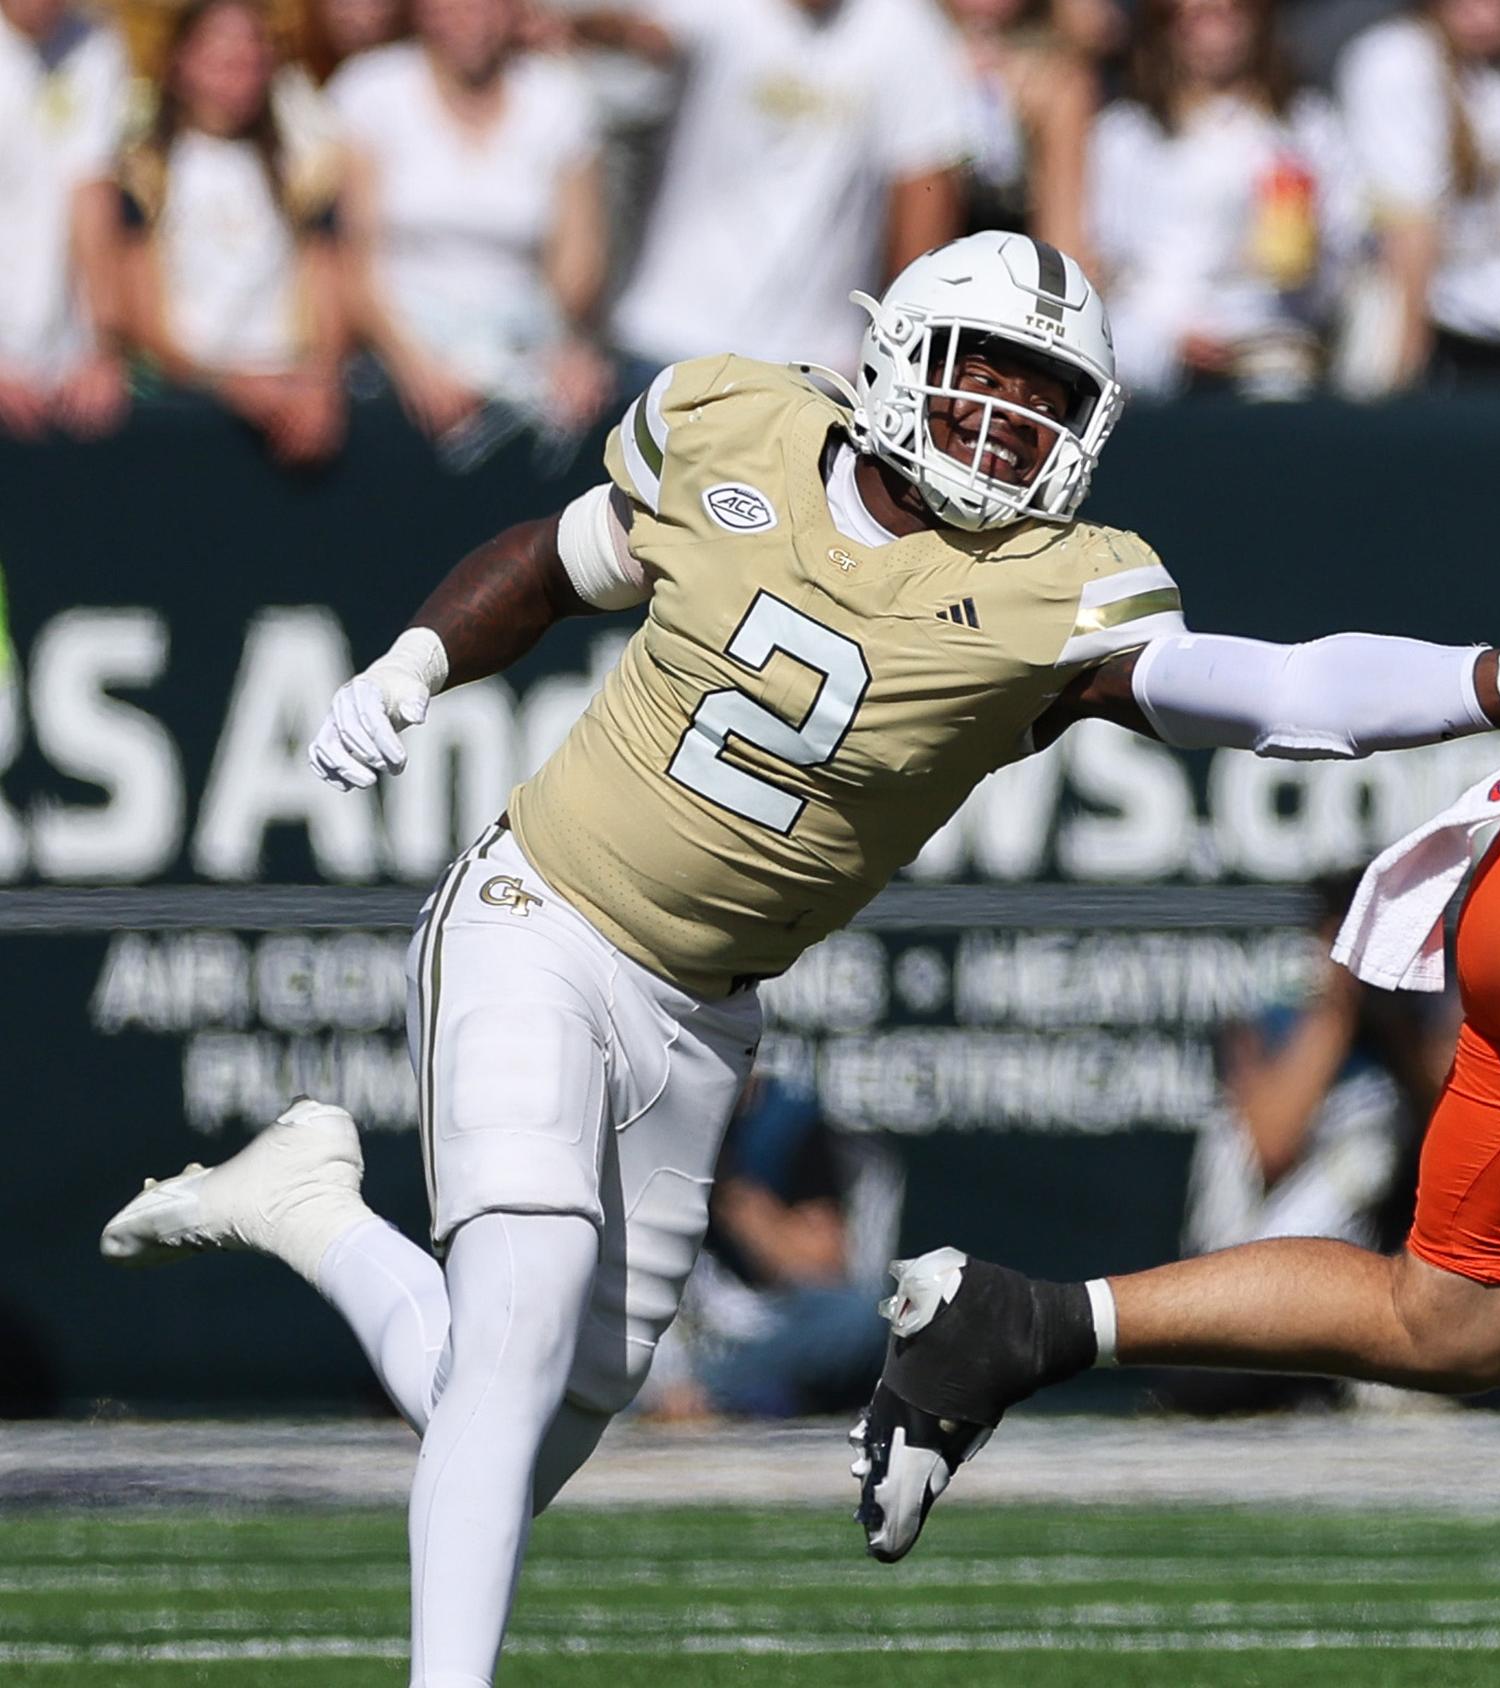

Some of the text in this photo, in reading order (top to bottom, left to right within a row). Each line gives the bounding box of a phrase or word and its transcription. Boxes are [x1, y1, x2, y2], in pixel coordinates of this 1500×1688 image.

[717, 496, 764, 519] ACC
[664, 587, 873, 838] 2
[479, 875, 544, 917] GT
